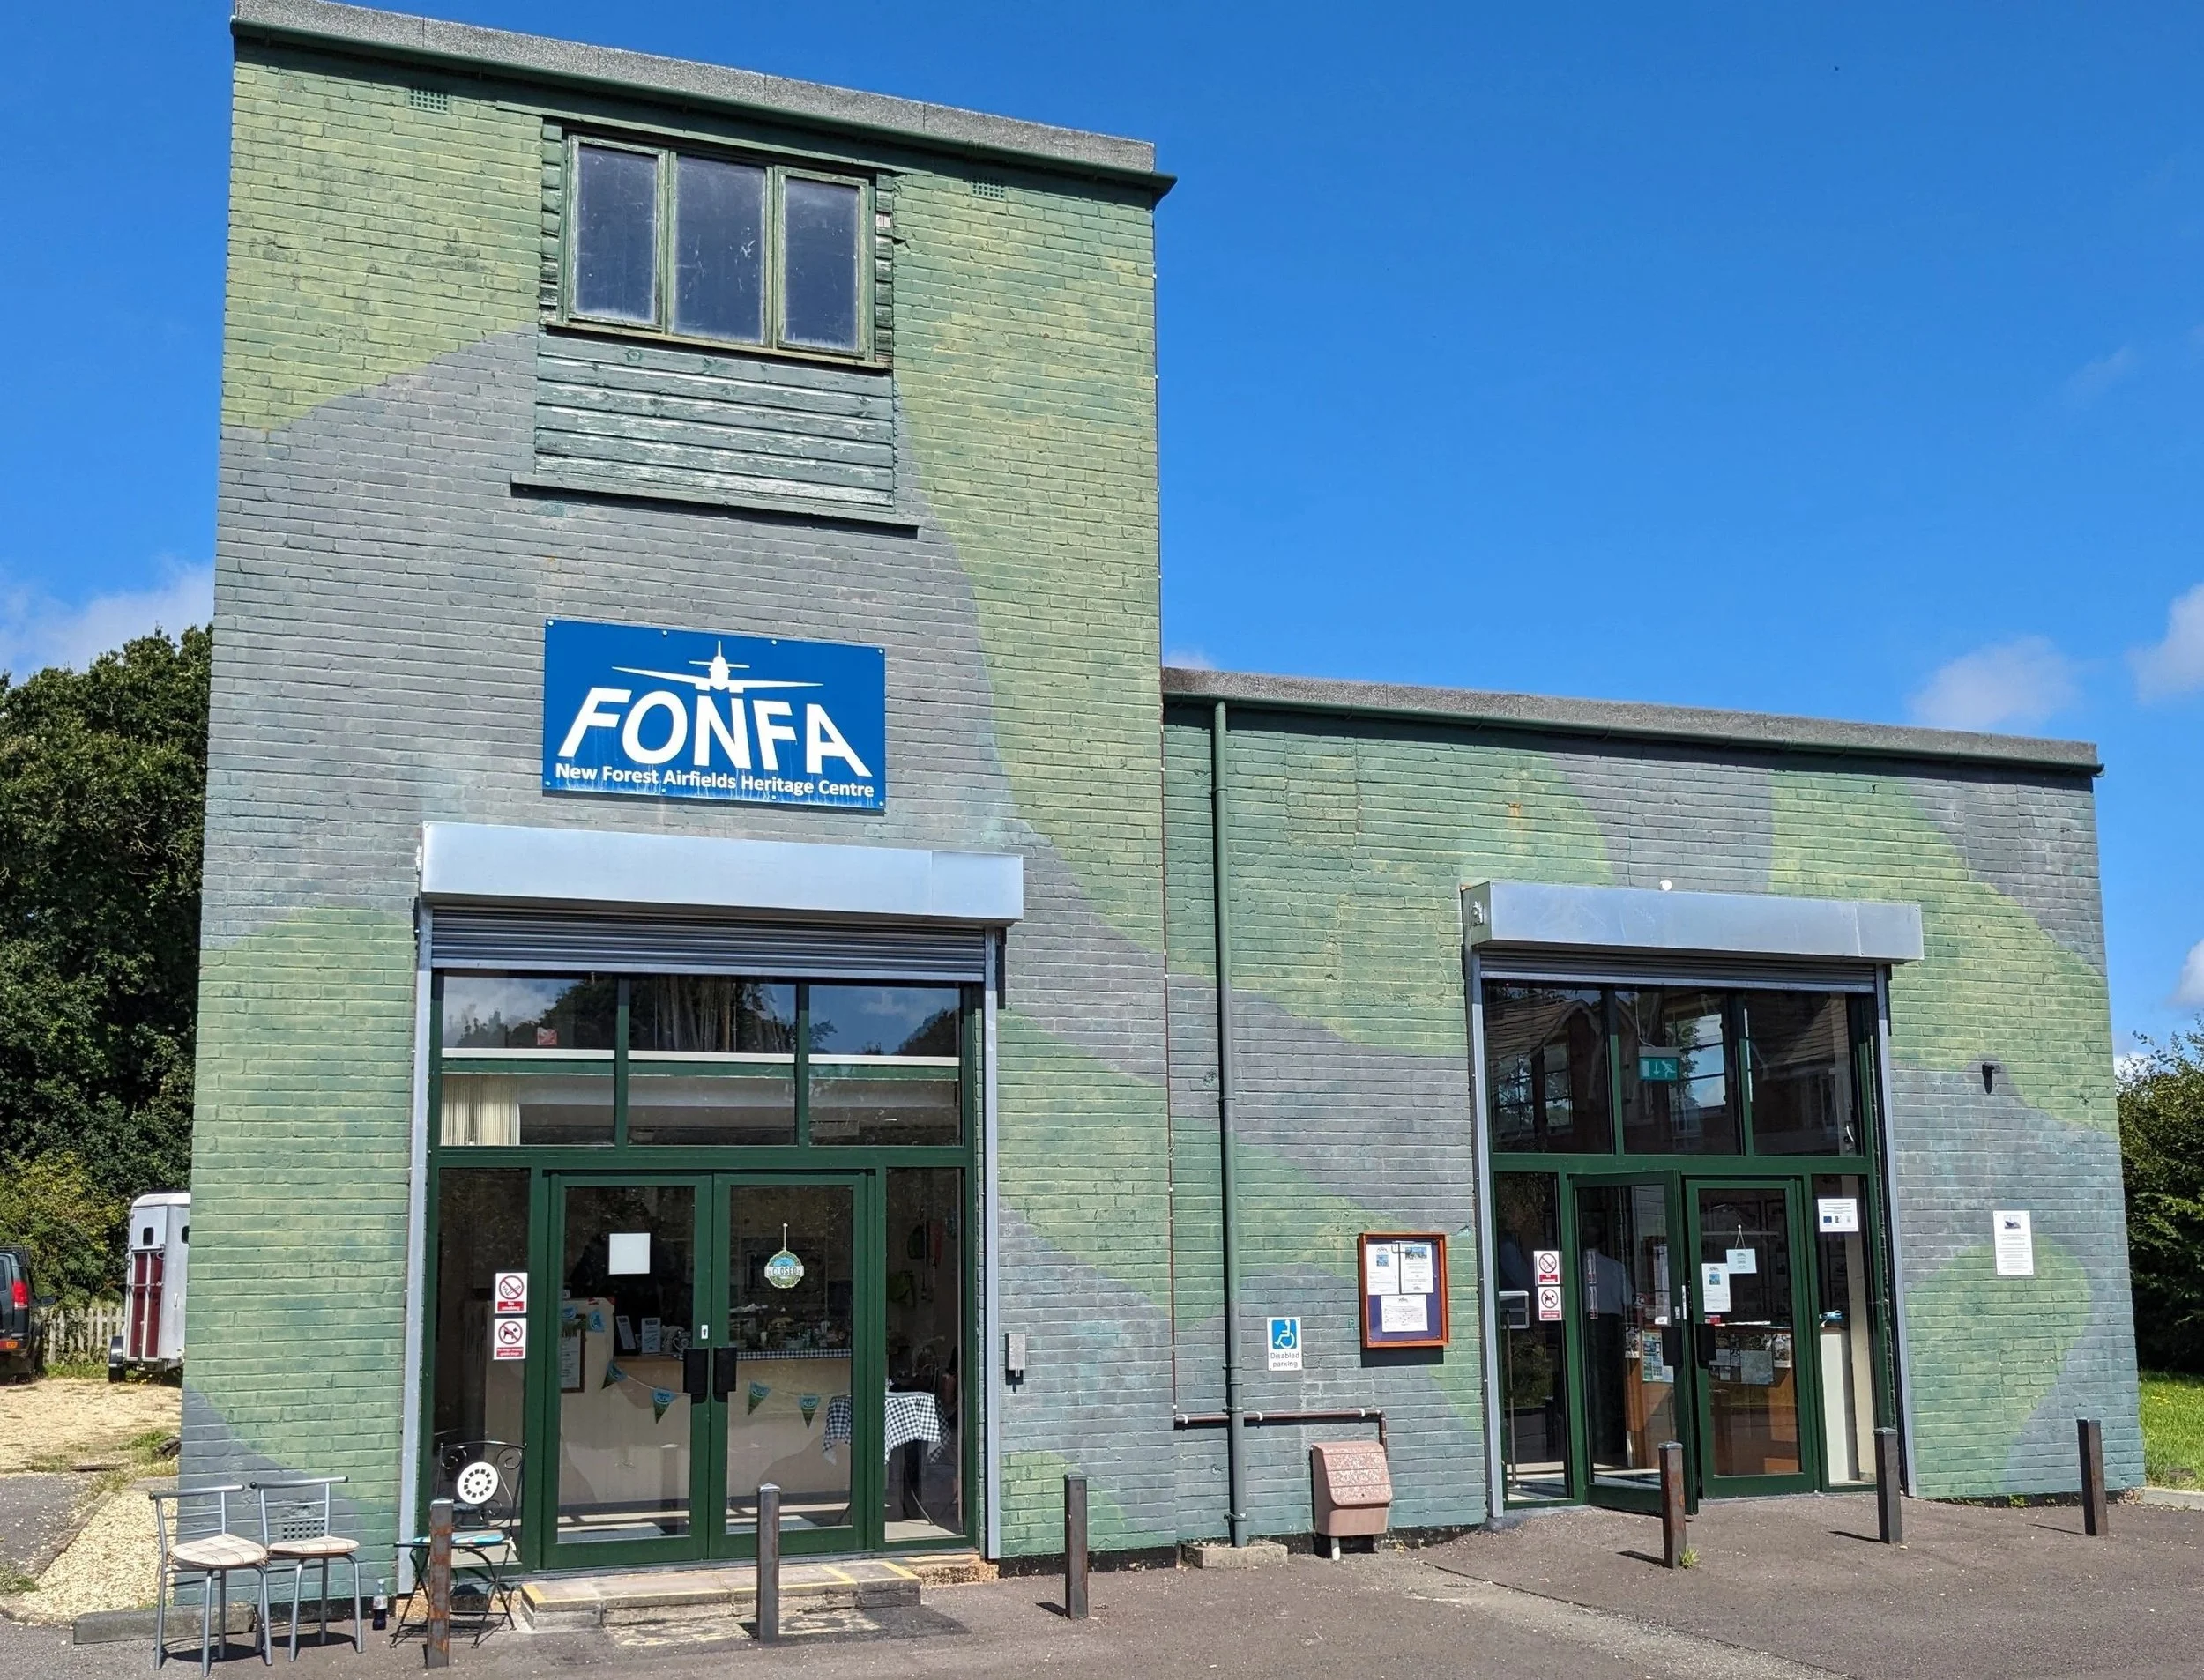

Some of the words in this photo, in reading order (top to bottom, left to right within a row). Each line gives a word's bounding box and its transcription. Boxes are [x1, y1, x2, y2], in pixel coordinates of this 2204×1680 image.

[557, 687, 873, 777] FONFA
[555, 762, 598, 781] New
[602, 766, 659, 784] Forest
[663, 769, 736, 790] Airfields
[741, 774, 814, 796] Heritage
[818, 780, 875, 798] Centre
[772, 1267, 798, 1275] CLOSED
